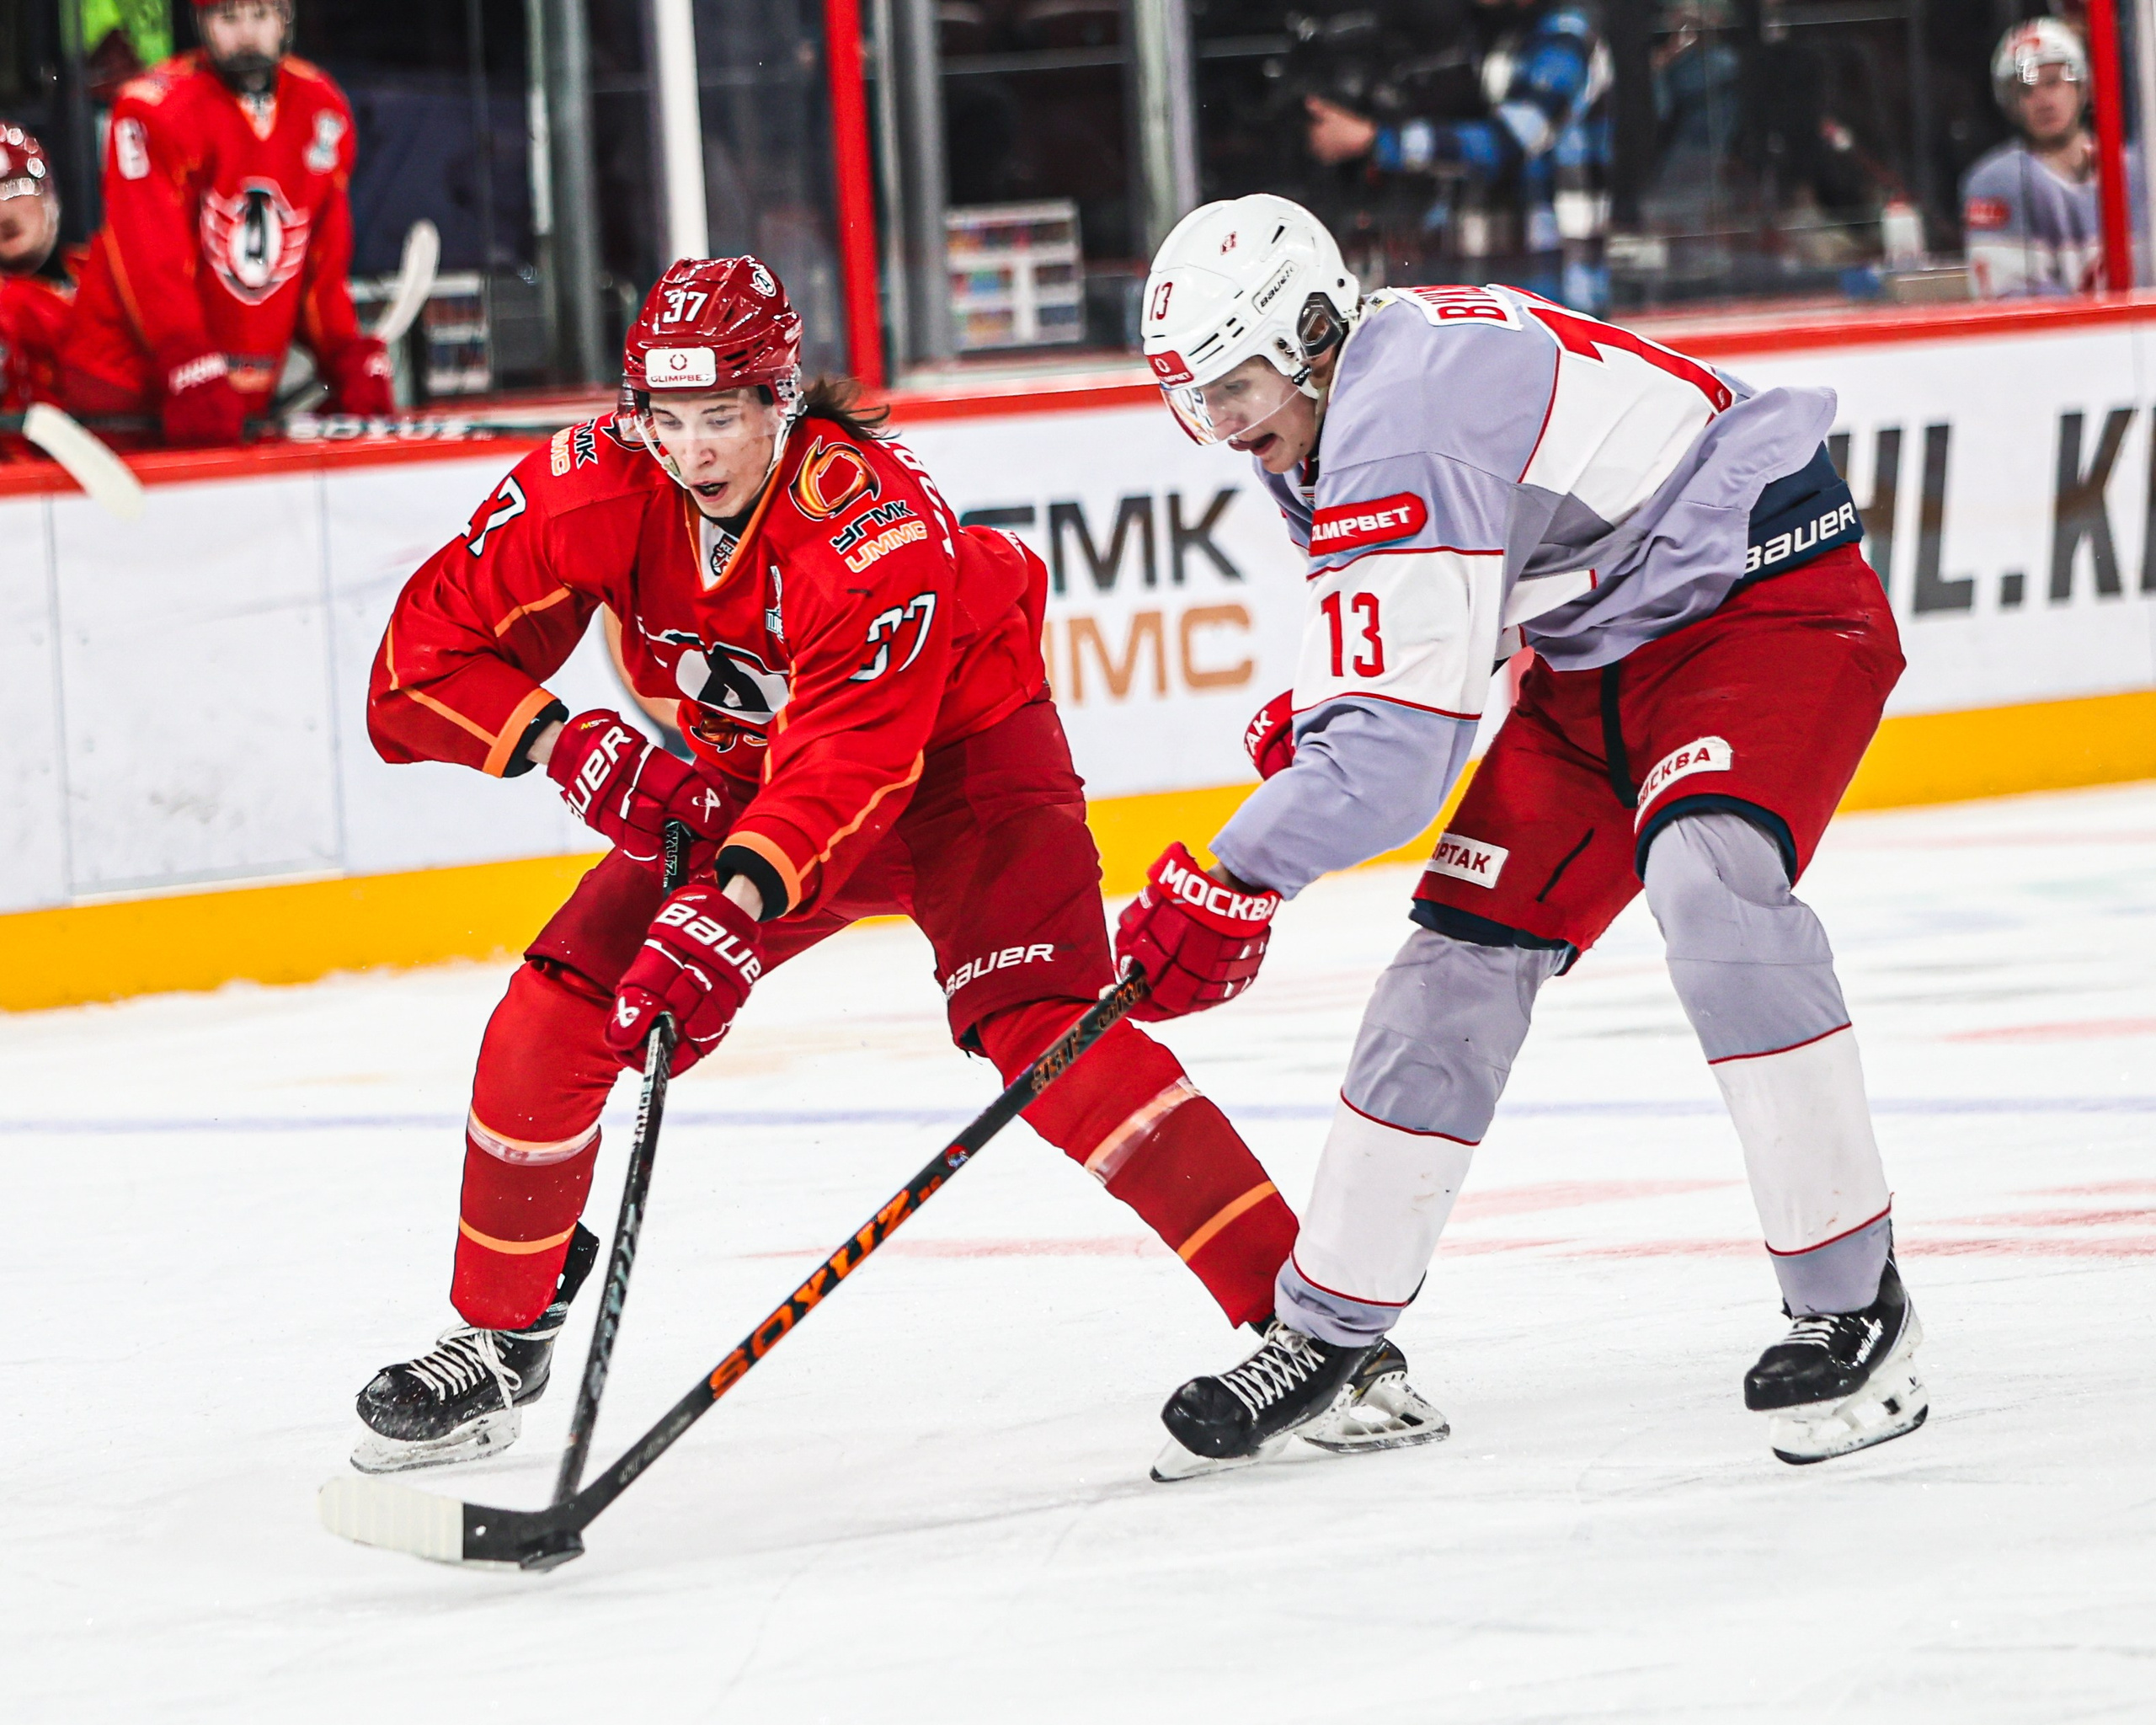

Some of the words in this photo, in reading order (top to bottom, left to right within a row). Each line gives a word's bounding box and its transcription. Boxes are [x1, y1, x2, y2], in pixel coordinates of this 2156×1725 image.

[662, 291, 708, 323] 37
[1150, 281, 1173, 321] 13
[829, 500, 918, 555] УГМК
[845, 521, 928, 574] UMMC
[847, 591, 937, 685] 37
[1043, 603, 1254, 704] MC
[1321, 590, 1385, 678] 13
[709, 1188, 913, 1400] SOYUZ
